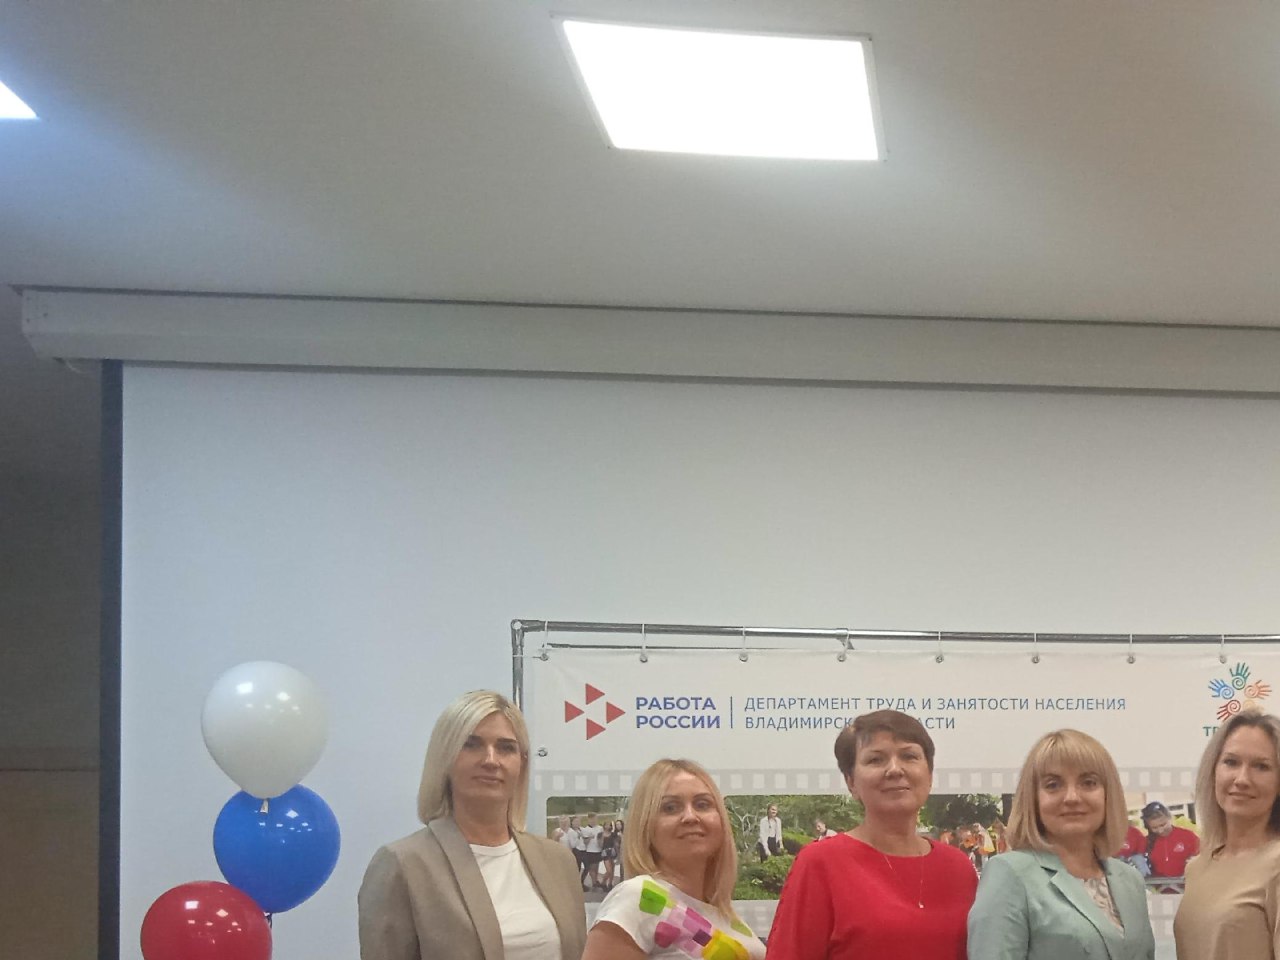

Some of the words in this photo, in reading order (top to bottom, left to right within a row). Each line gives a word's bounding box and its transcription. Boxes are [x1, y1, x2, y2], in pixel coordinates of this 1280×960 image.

[635, 697, 716, 710] РАБОТА
[744, 697, 860, 711] ДЕПАРТАМЕНТ
[866, 698, 916, 711] ТРУДА
[922, 698, 931, 710] И
[937, 698, 1029, 710] ЗАНЯТОСТИ
[1035, 698, 1126, 711] НАСЕЛЕНИЯ
[635, 715, 720, 729] РОССИИ
[745, 716, 853, 731] ВЛАДИМИРСК
